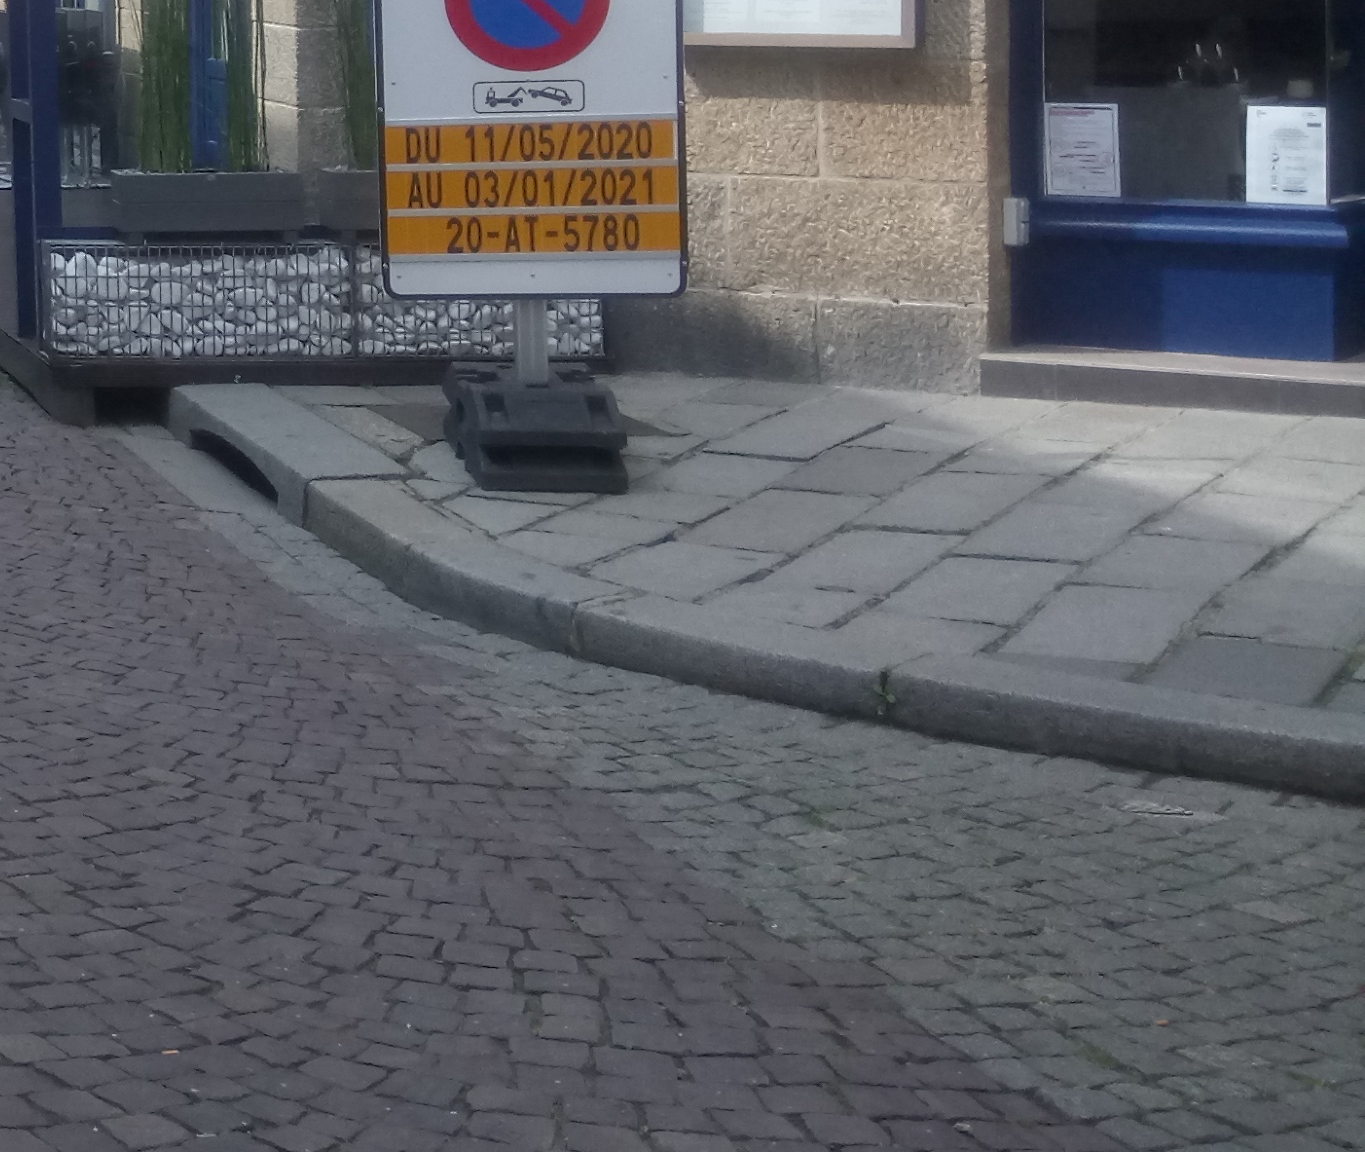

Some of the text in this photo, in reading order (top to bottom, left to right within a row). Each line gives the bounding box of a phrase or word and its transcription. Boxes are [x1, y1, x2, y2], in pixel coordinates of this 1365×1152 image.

[405, 121, 653, 164] DU 11/05/2020
[407, 168, 655, 209] AU 03/01/2021
[446, 213, 640, 254] 20-AT-5780
